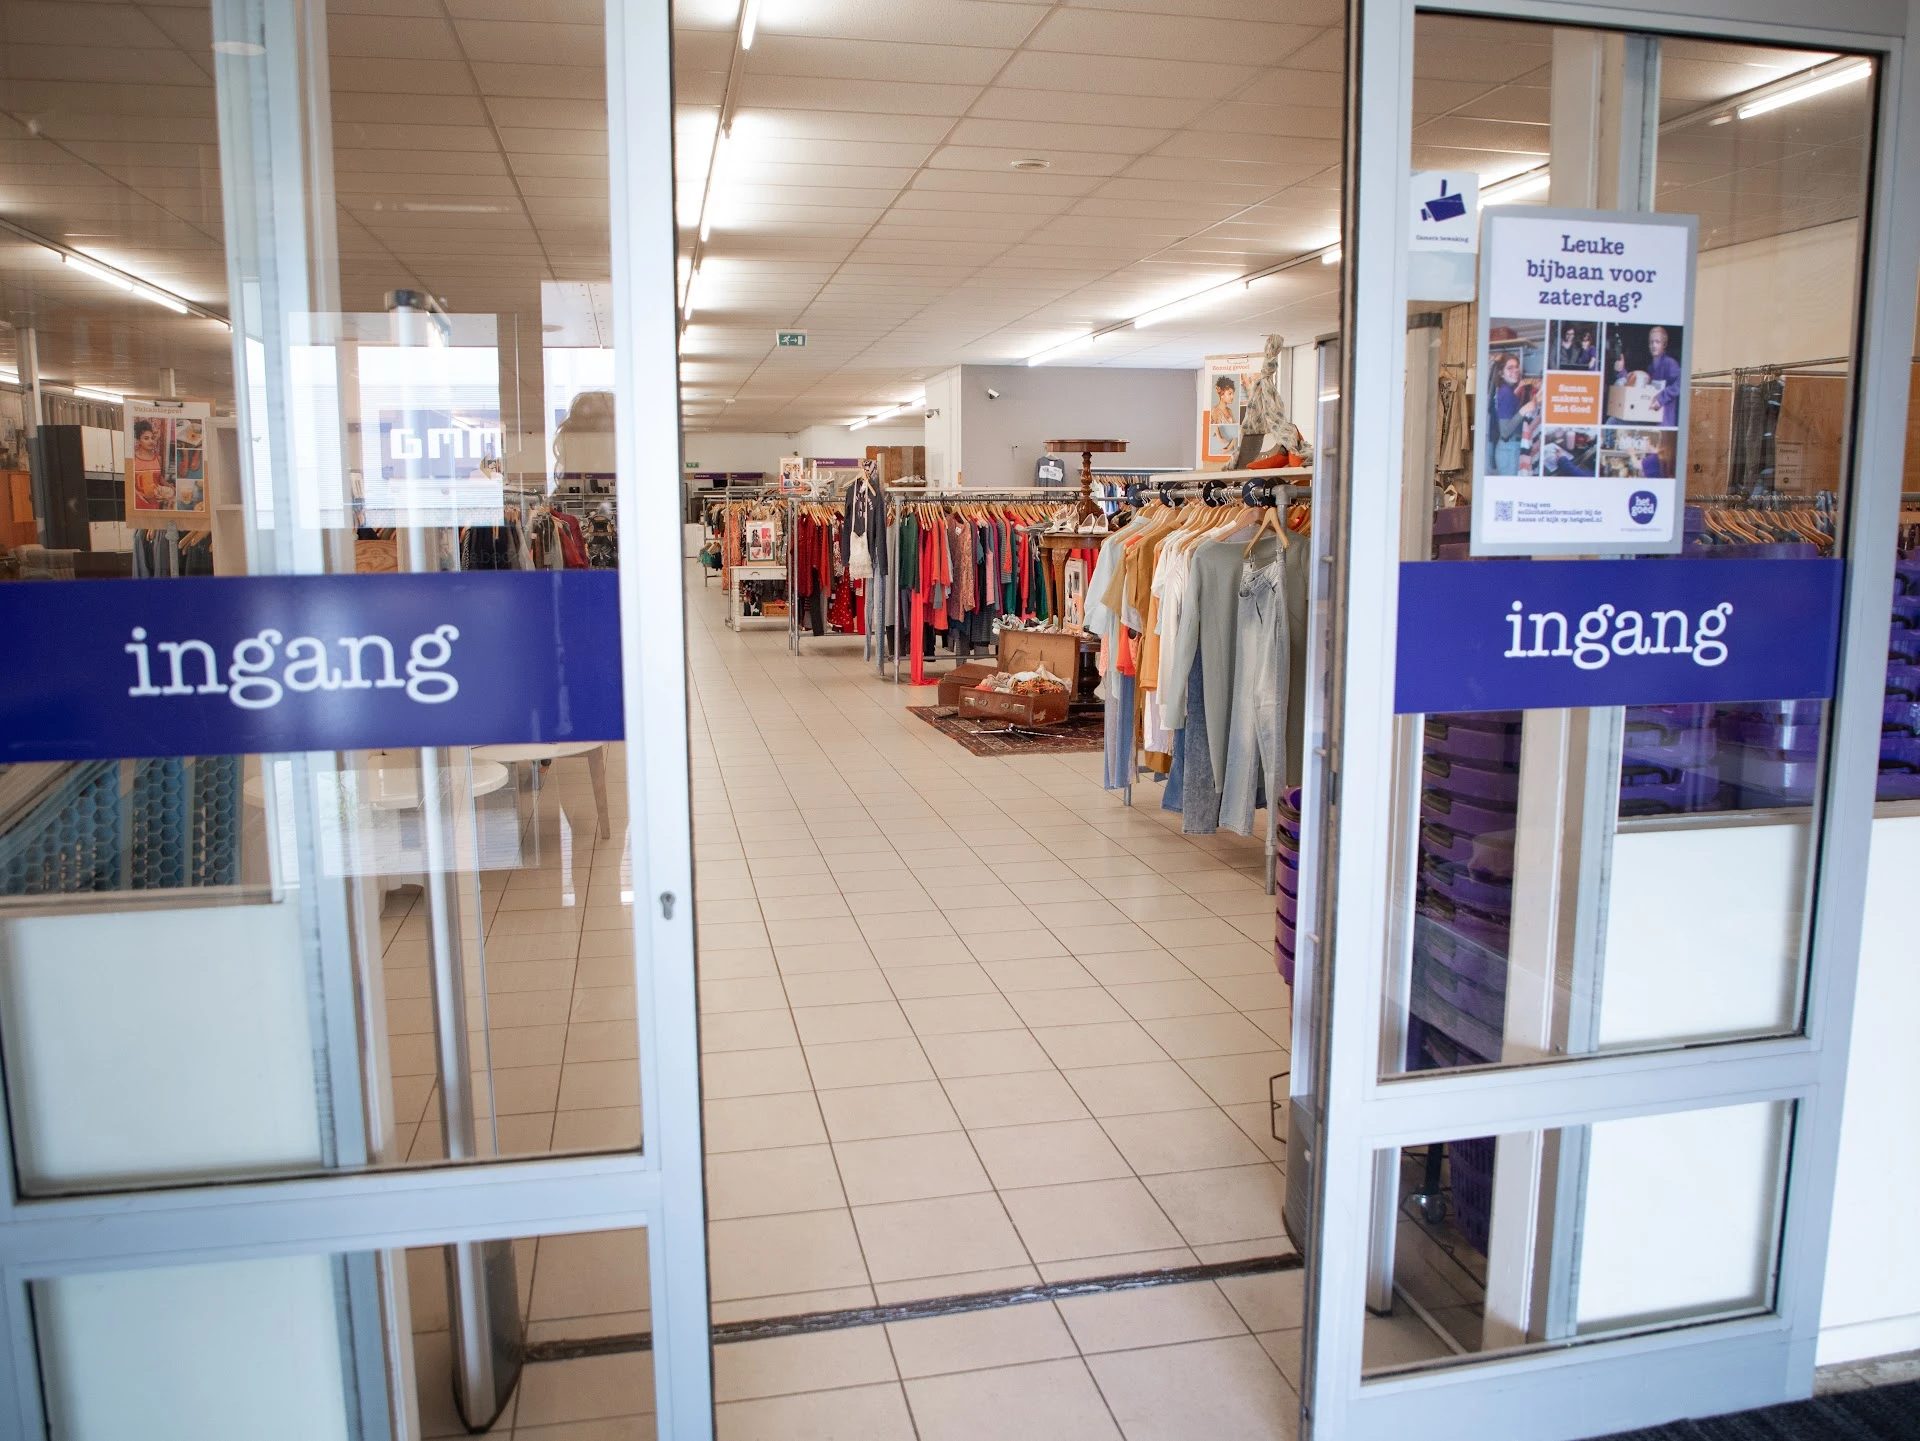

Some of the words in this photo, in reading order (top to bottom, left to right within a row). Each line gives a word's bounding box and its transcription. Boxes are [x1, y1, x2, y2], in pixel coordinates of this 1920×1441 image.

[1561, 234, 1625, 255] Leuke
[1526, 258, 1604, 283] bijbaan
[1609, 267, 1657, 283] voor
[1539, 288, 1643, 313] zaterdag?
[1631, 503, 1654, 517] goed
[1635, 495, 1650, 506] het
[1504, 600, 1734, 670] ingang
[124, 624, 460, 710] ingang
